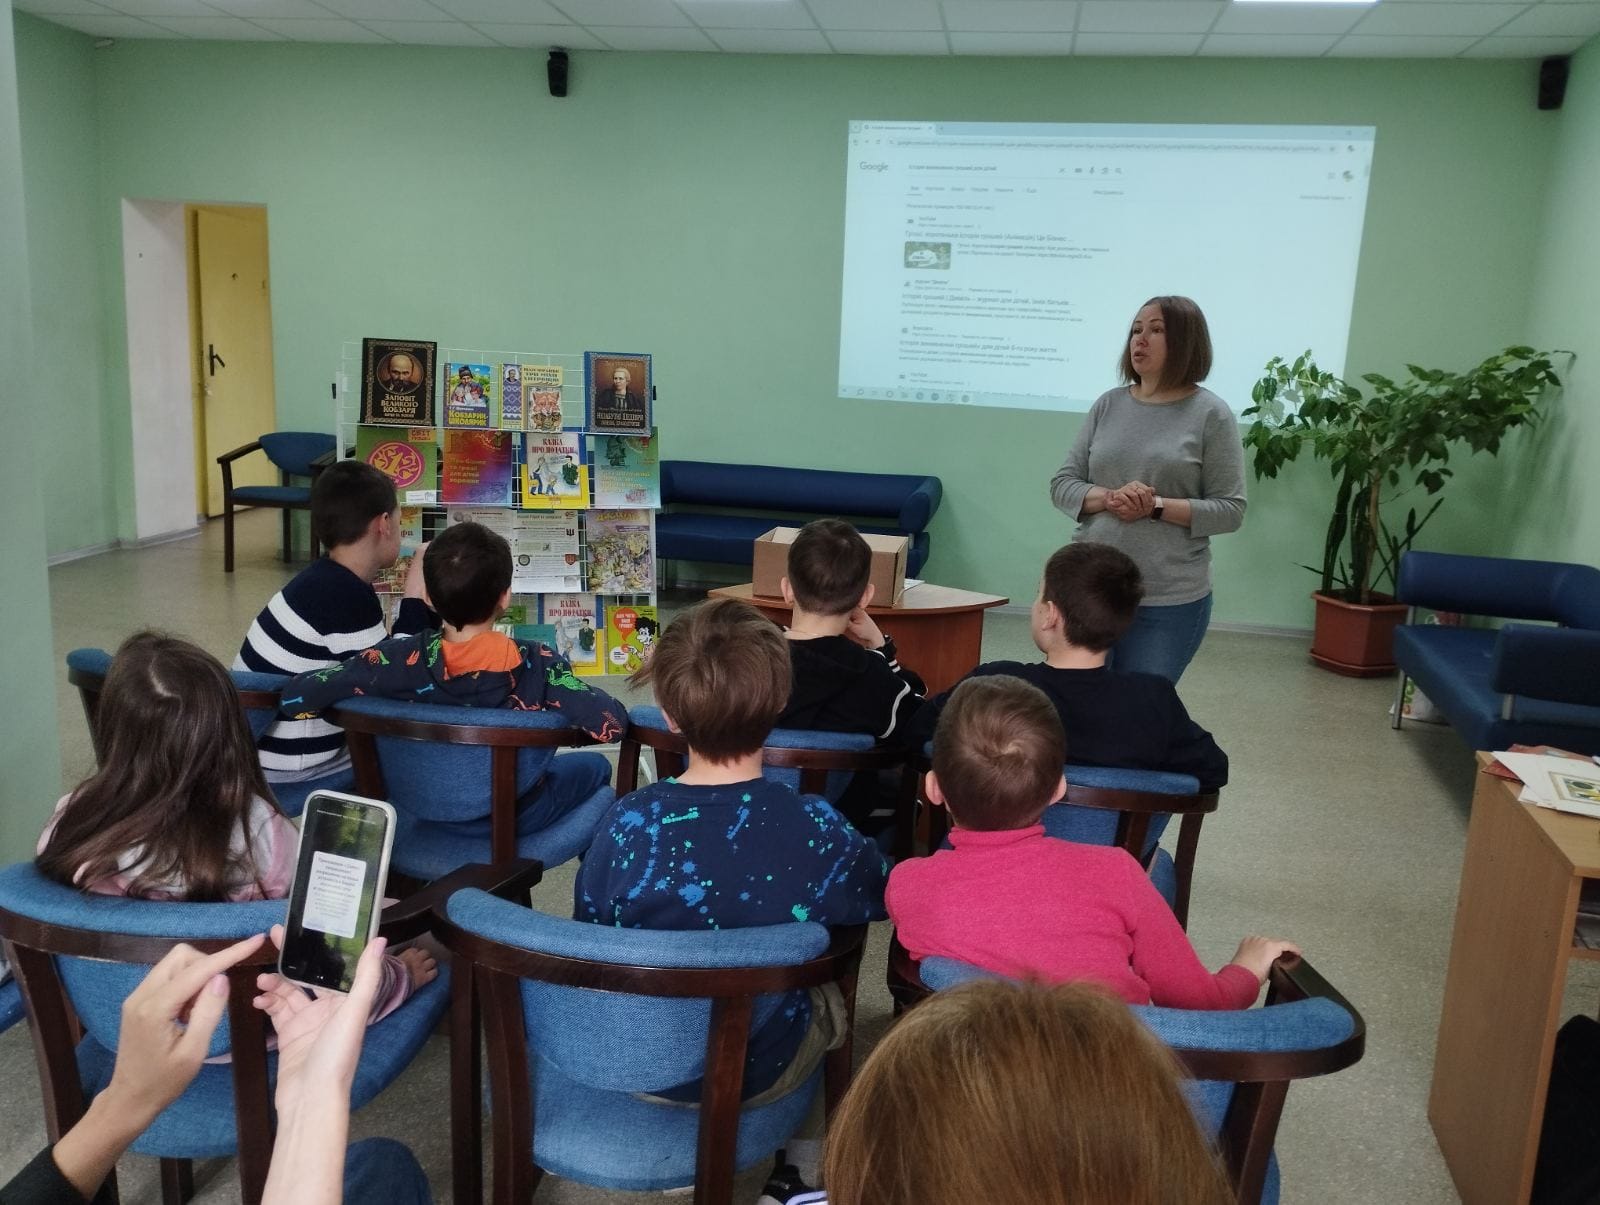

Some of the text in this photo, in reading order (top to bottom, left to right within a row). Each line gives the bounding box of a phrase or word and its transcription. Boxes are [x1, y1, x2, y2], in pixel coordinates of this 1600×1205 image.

[859, 161, 888, 173] Google
[381, 400, 419, 408] ВЕЛИКОГО
[560, 600, 581, 608] КАЗКА
[549, 609, 562, 617] ПРО
